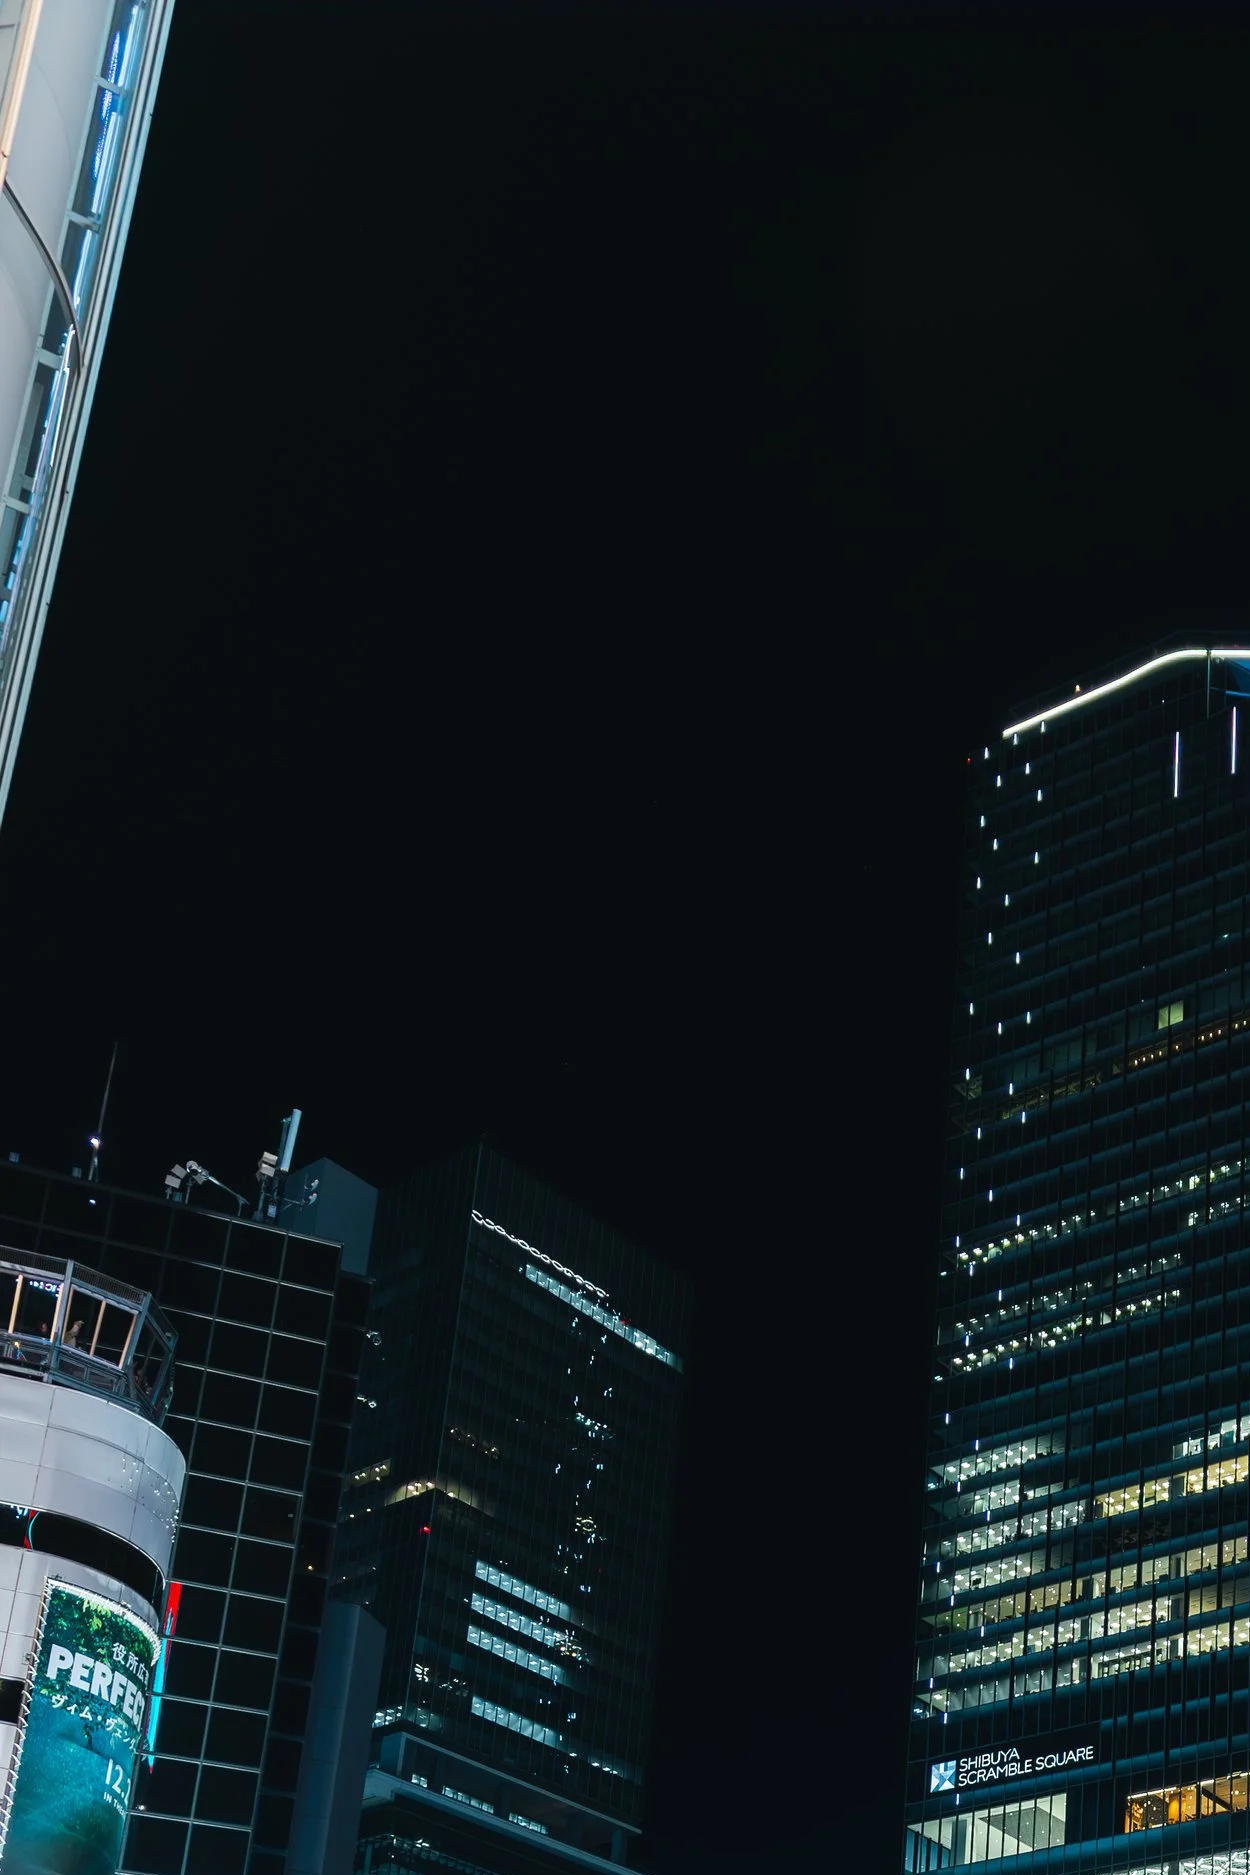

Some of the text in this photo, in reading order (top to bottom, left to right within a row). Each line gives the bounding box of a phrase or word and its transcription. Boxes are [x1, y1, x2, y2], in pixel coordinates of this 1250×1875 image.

[958, 1745, 1094, 1787] SCRAMBLE SQUARE
[959, 1747, 1020, 1772] SHIBUYA
